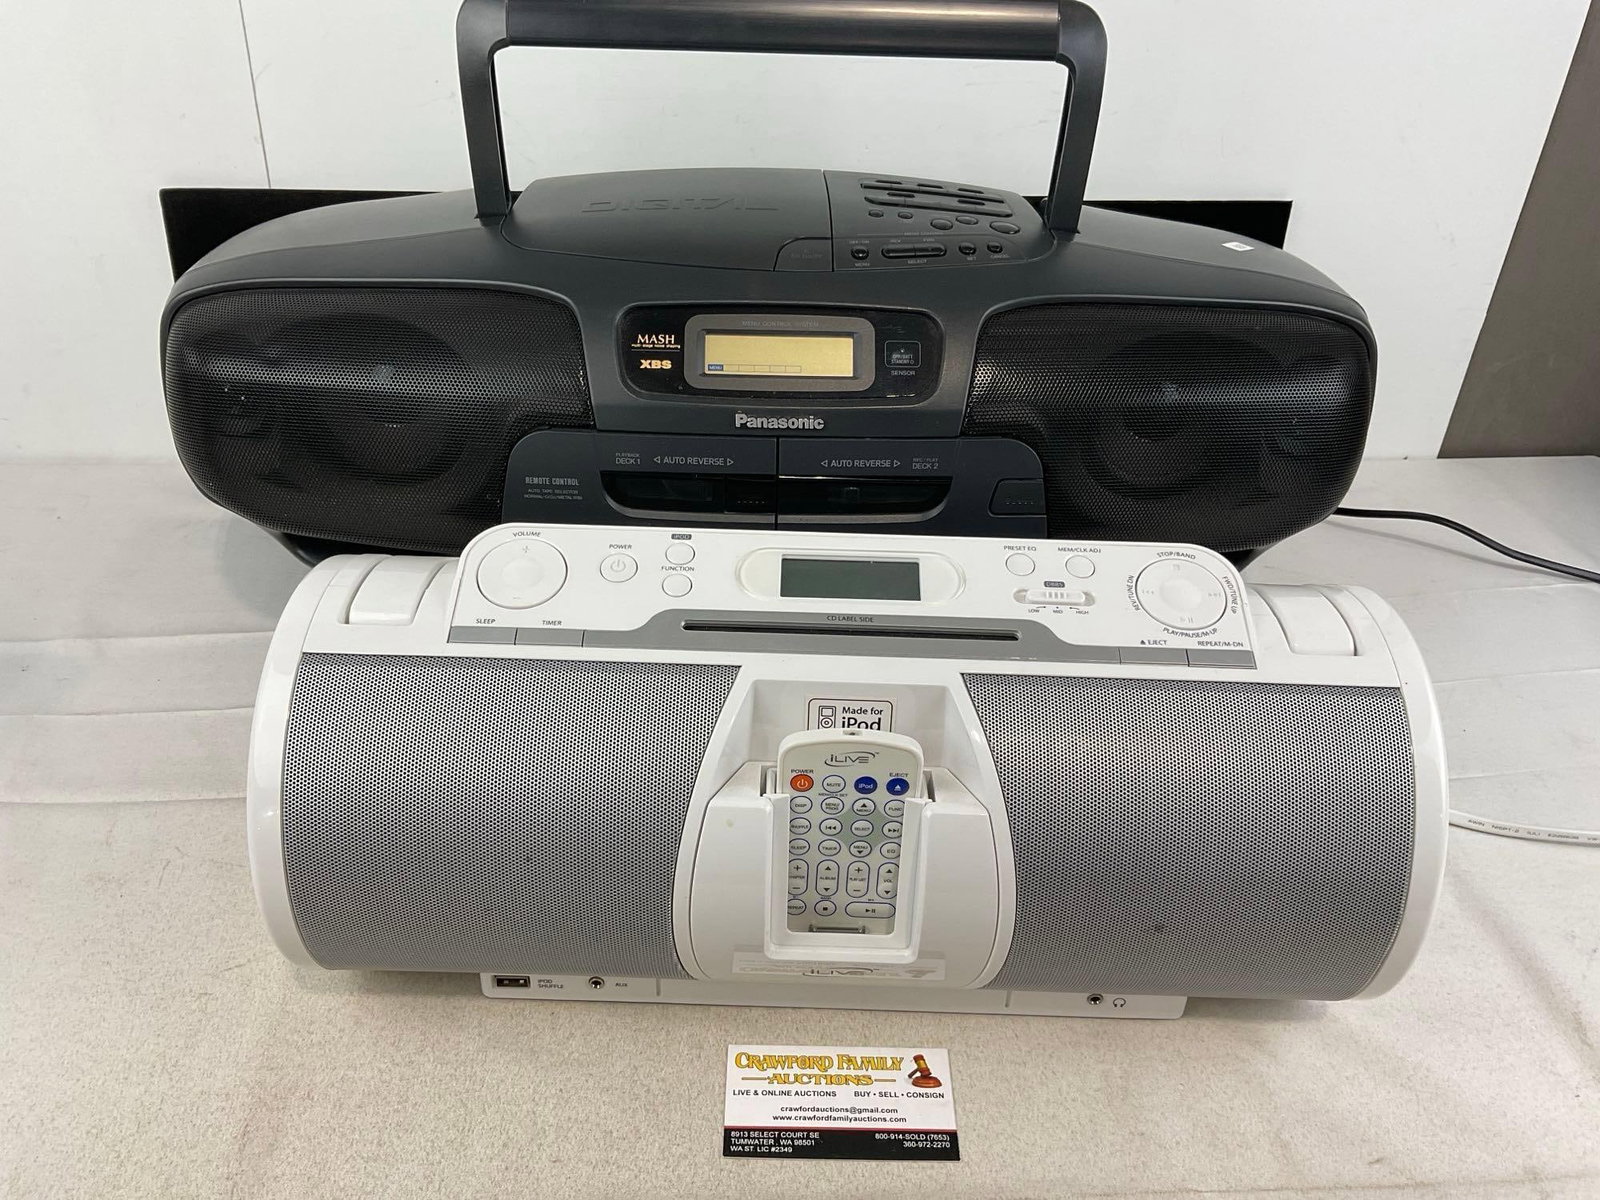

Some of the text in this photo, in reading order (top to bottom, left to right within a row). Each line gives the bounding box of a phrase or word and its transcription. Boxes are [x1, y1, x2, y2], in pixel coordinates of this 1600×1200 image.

[637, 334, 675, 345] MASH
[639, 359, 672, 369] XBS
[735, 413, 825, 431] Panasonic
[616, 457, 637, 465] DECK
[663, 456, 725, 466] AUTO REVERSE
[830, 459, 891, 468] AUTO REVERSE
[525, 476, 580, 486] REMOTE CONTROL
[1157, 551, 1197, 560] STOP/BAND
[1222, 576, 1238, 615] FWD/TUNE UP
[859, 615, 875, 623] SIDE
[1162, 627, 1218, 639] PLAY/PAUSE/M-UP
[1197, 640, 1244, 648] REPEAT/M-DN
[842, 706, 884, 715] Made for
[842, 717, 882, 732] iPod
[734, 1052, 905, 1073] CRAWFORD FAMILY
[767, 1073, 874, 1086] AUCTIONS
[761, 1089, 793, 1097] ONLINE
[794, 1090, 838, 1098] AUCTIONS
[853, 1090, 871, 1098] BUY
[906, 1091, 945, 1099] CONSIGN
[780, 1105, 899, 1115] crawfordauctions@gmail.com
[772, 1114, 907, 1124] www.crawfordfamilyauctions.com
[875, 1133, 951, 1142] 800-914-SOLD (7653)
[730, 1138, 775, 1146] TUMWATER
[793, 1139, 816, 1147] 98501
[903, 1140, 951, 1149] 360-972-2270
[730, 1145, 743, 1153] WA
[770, 1146, 794, 1154] #2349
